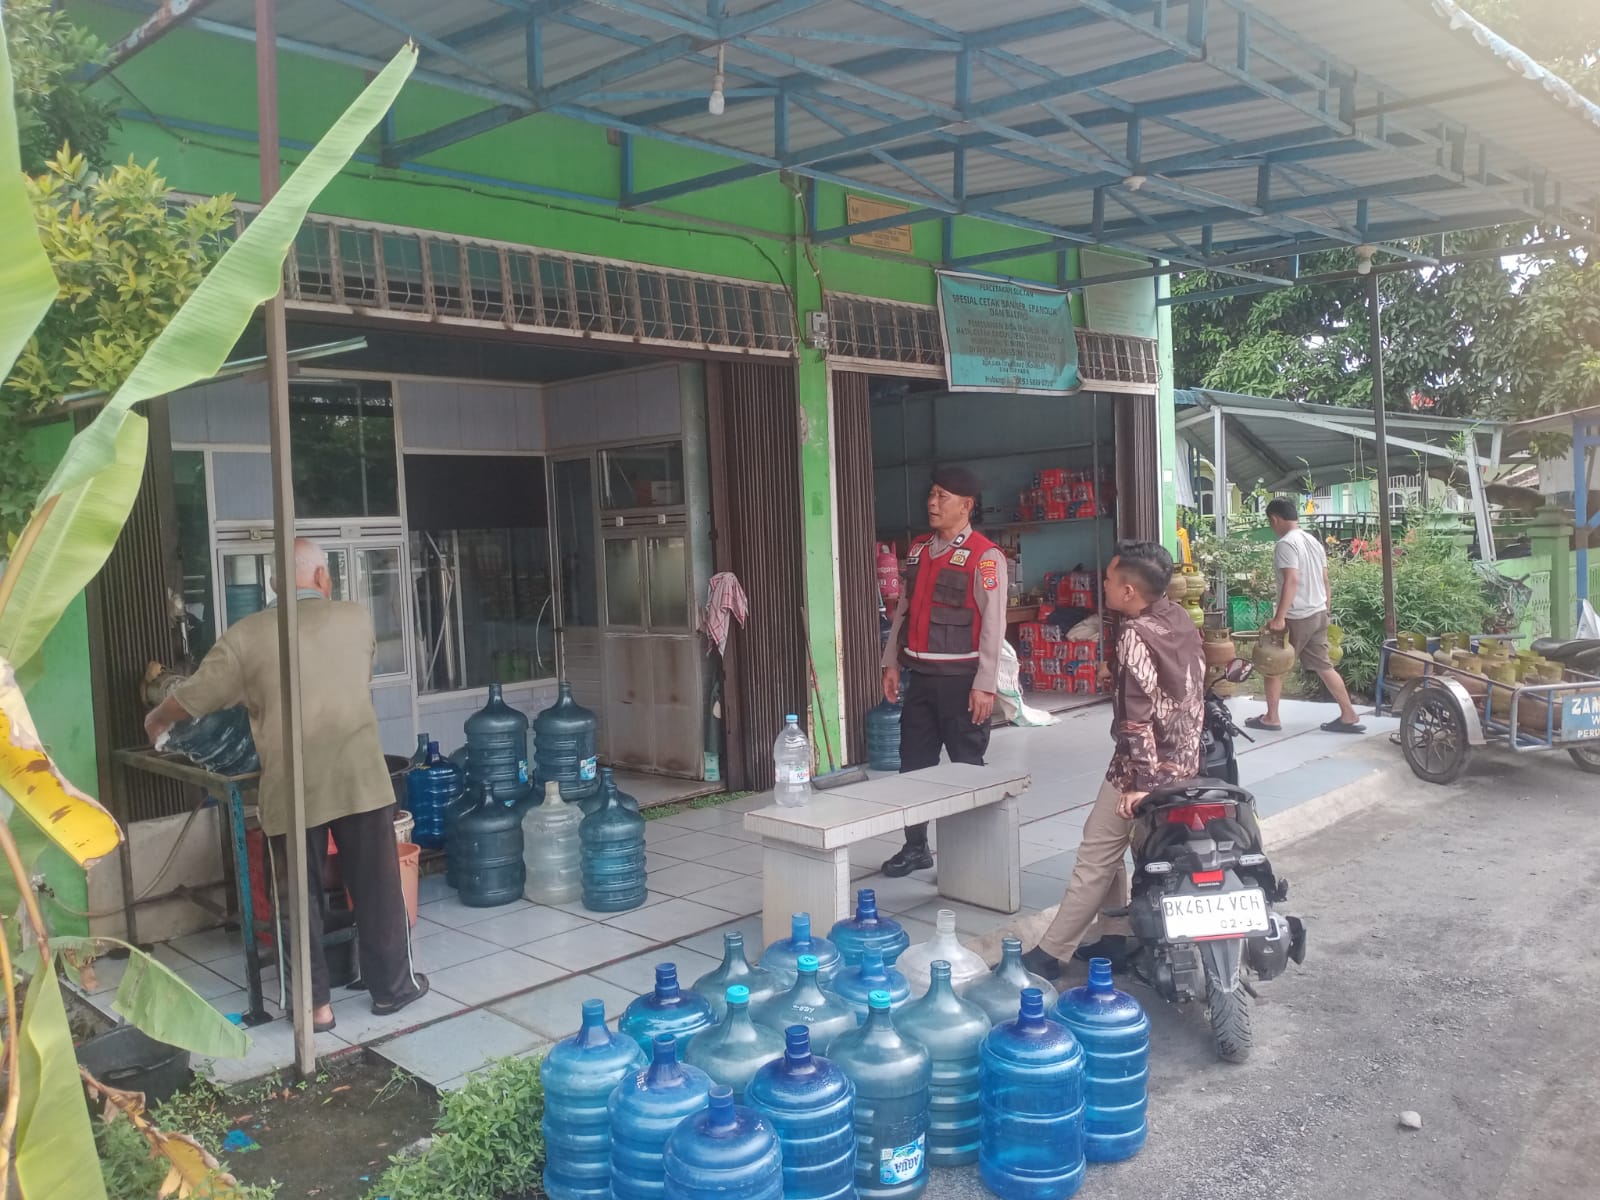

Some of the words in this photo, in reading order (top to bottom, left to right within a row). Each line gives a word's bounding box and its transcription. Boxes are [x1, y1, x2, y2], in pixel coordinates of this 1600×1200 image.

[952, 294, 978, 306] SPESIAL
[979, 296, 1000, 307] CETAK
[1164, 900, 1184, 917] BK
[1186, 898, 1224, 915] 4614
[1229, 895, 1260, 911] VCH
[894, 1154, 920, 1174] AQUA
